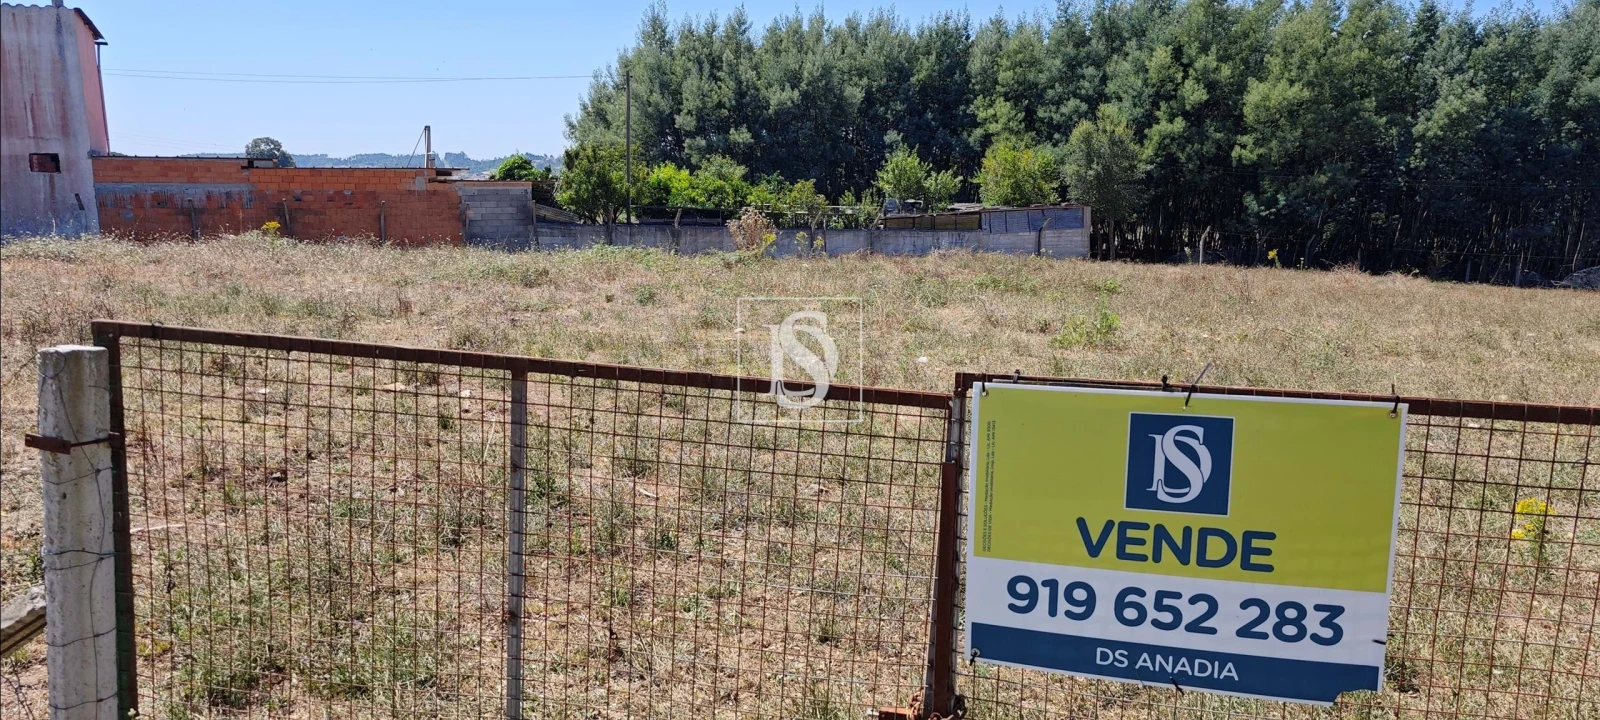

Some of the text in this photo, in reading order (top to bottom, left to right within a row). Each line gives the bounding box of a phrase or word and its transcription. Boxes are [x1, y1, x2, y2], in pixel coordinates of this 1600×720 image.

[1075, 516, 1277, 573] VENDE
[1006, 574, 1346, 647] 919 652 283
[1095, 647, 1239, 682] DS ANADIA
